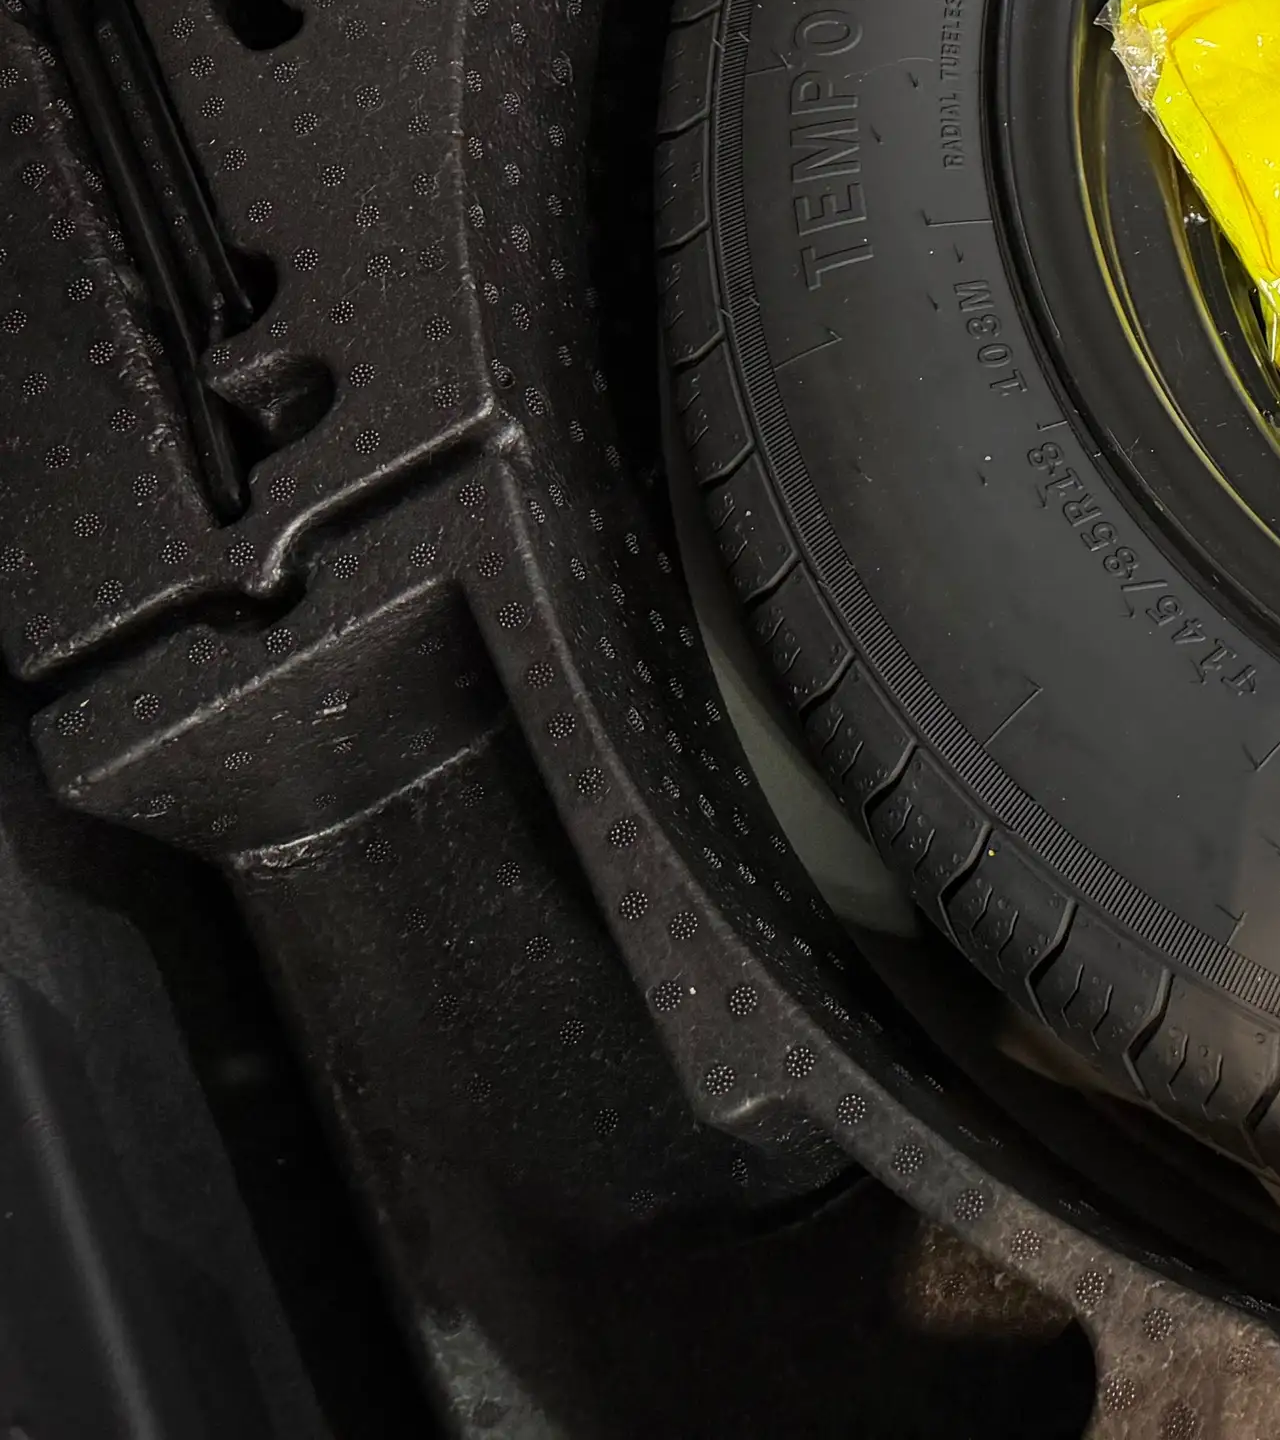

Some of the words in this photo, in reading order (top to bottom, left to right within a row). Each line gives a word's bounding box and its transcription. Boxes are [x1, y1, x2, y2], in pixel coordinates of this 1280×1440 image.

[943, 83, 966, 170] RADIAL
[953, 278, 1028, 396] 103M
[1027, 441, 1257, 696] T145/85R18
